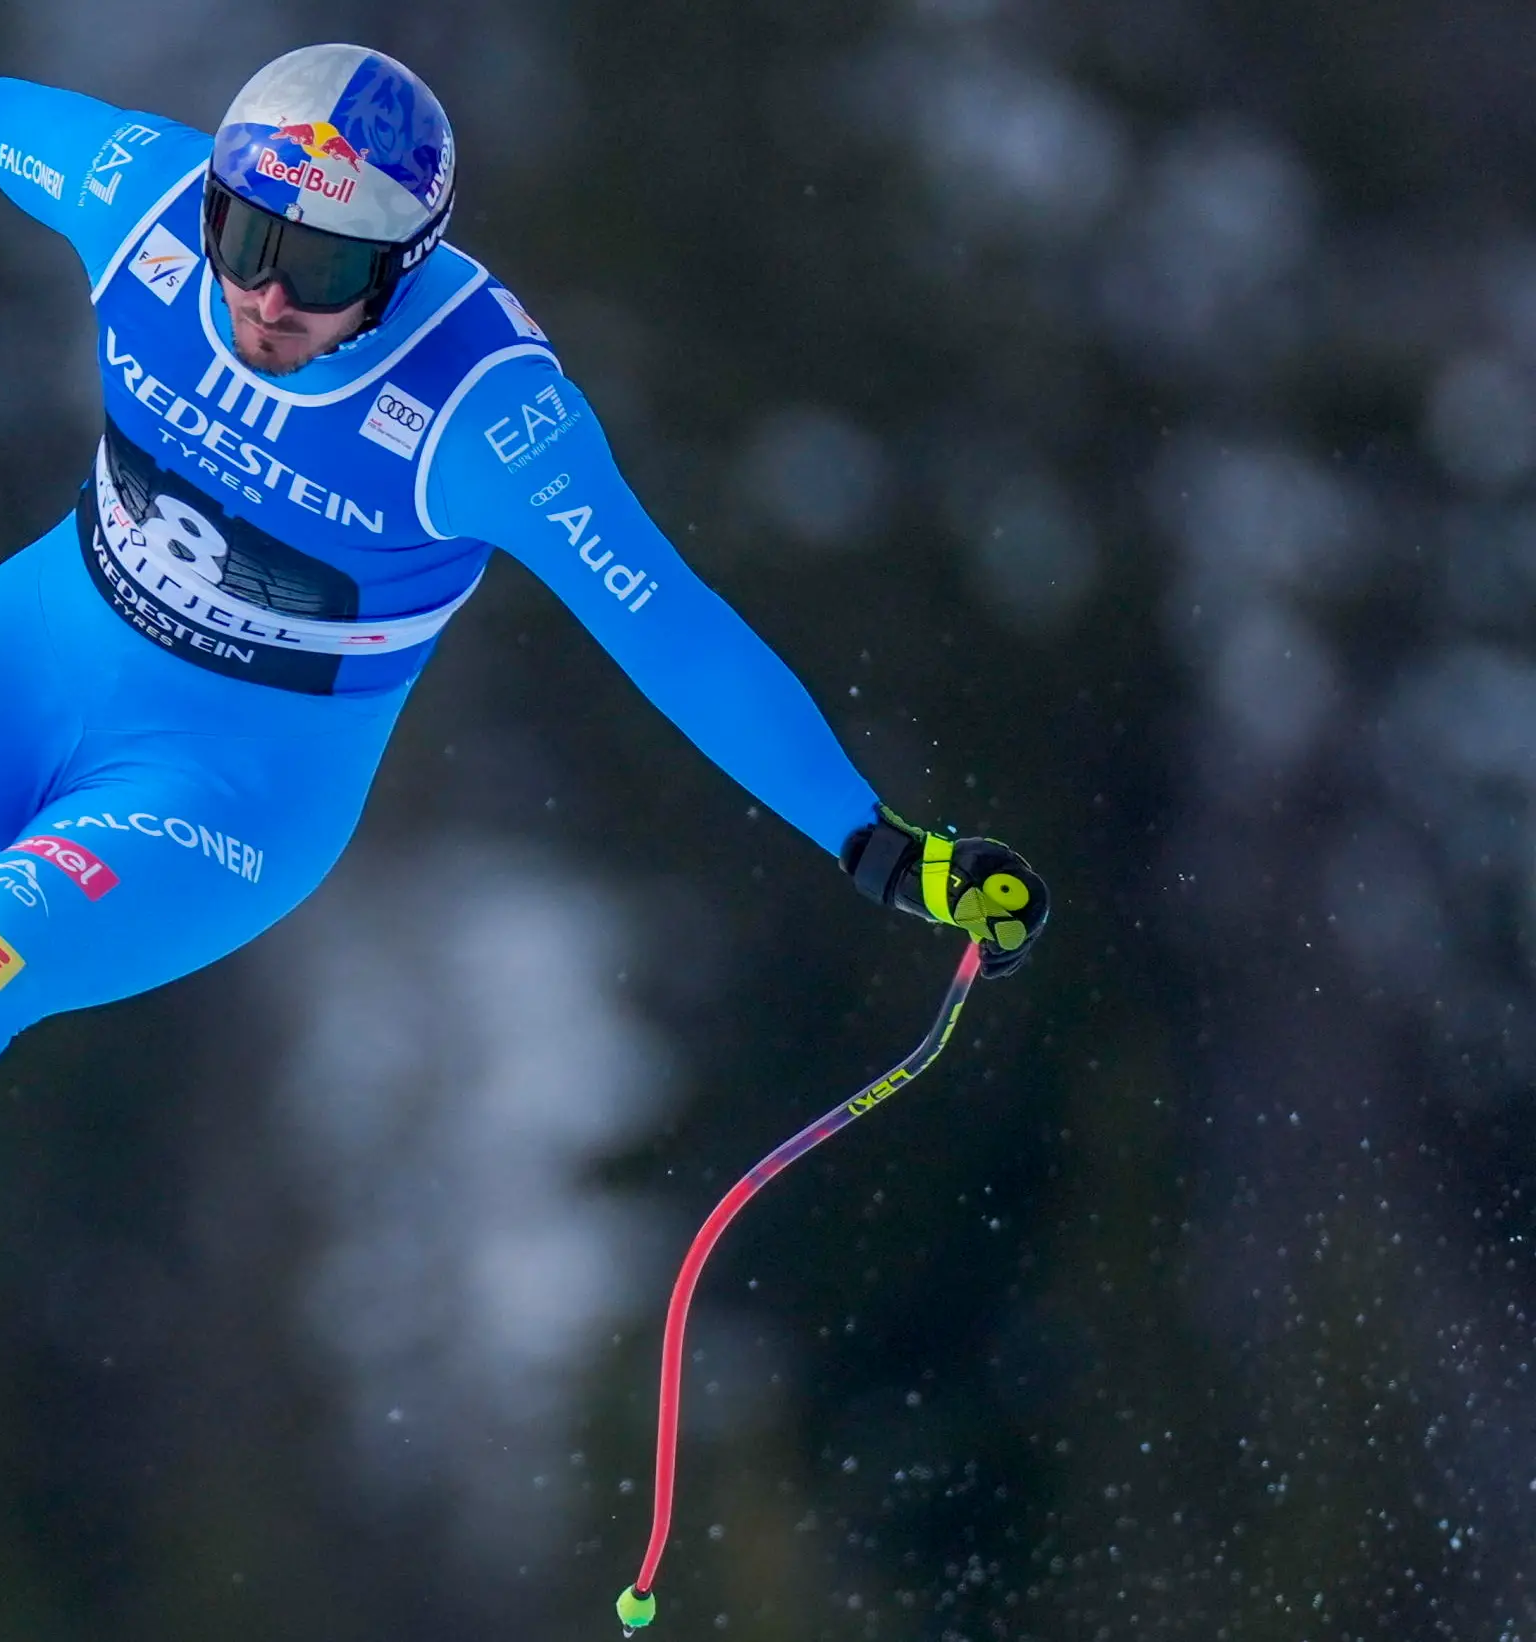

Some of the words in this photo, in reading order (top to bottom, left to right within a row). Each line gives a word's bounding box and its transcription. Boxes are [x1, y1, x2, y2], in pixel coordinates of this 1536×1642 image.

[258, 148, 306, 187] Red
[304, 166, 356, 203] Bull
[106, 326, 384, 534] VREDESTEIN
[158, 427, 263, 505] TYRES
[137, 494, 228, 587] 8
[546, 505, 658, 613] Audi
[92, 524, 255, 664] VREDESTEIN
[113, 594, 174, 647] TYRES
